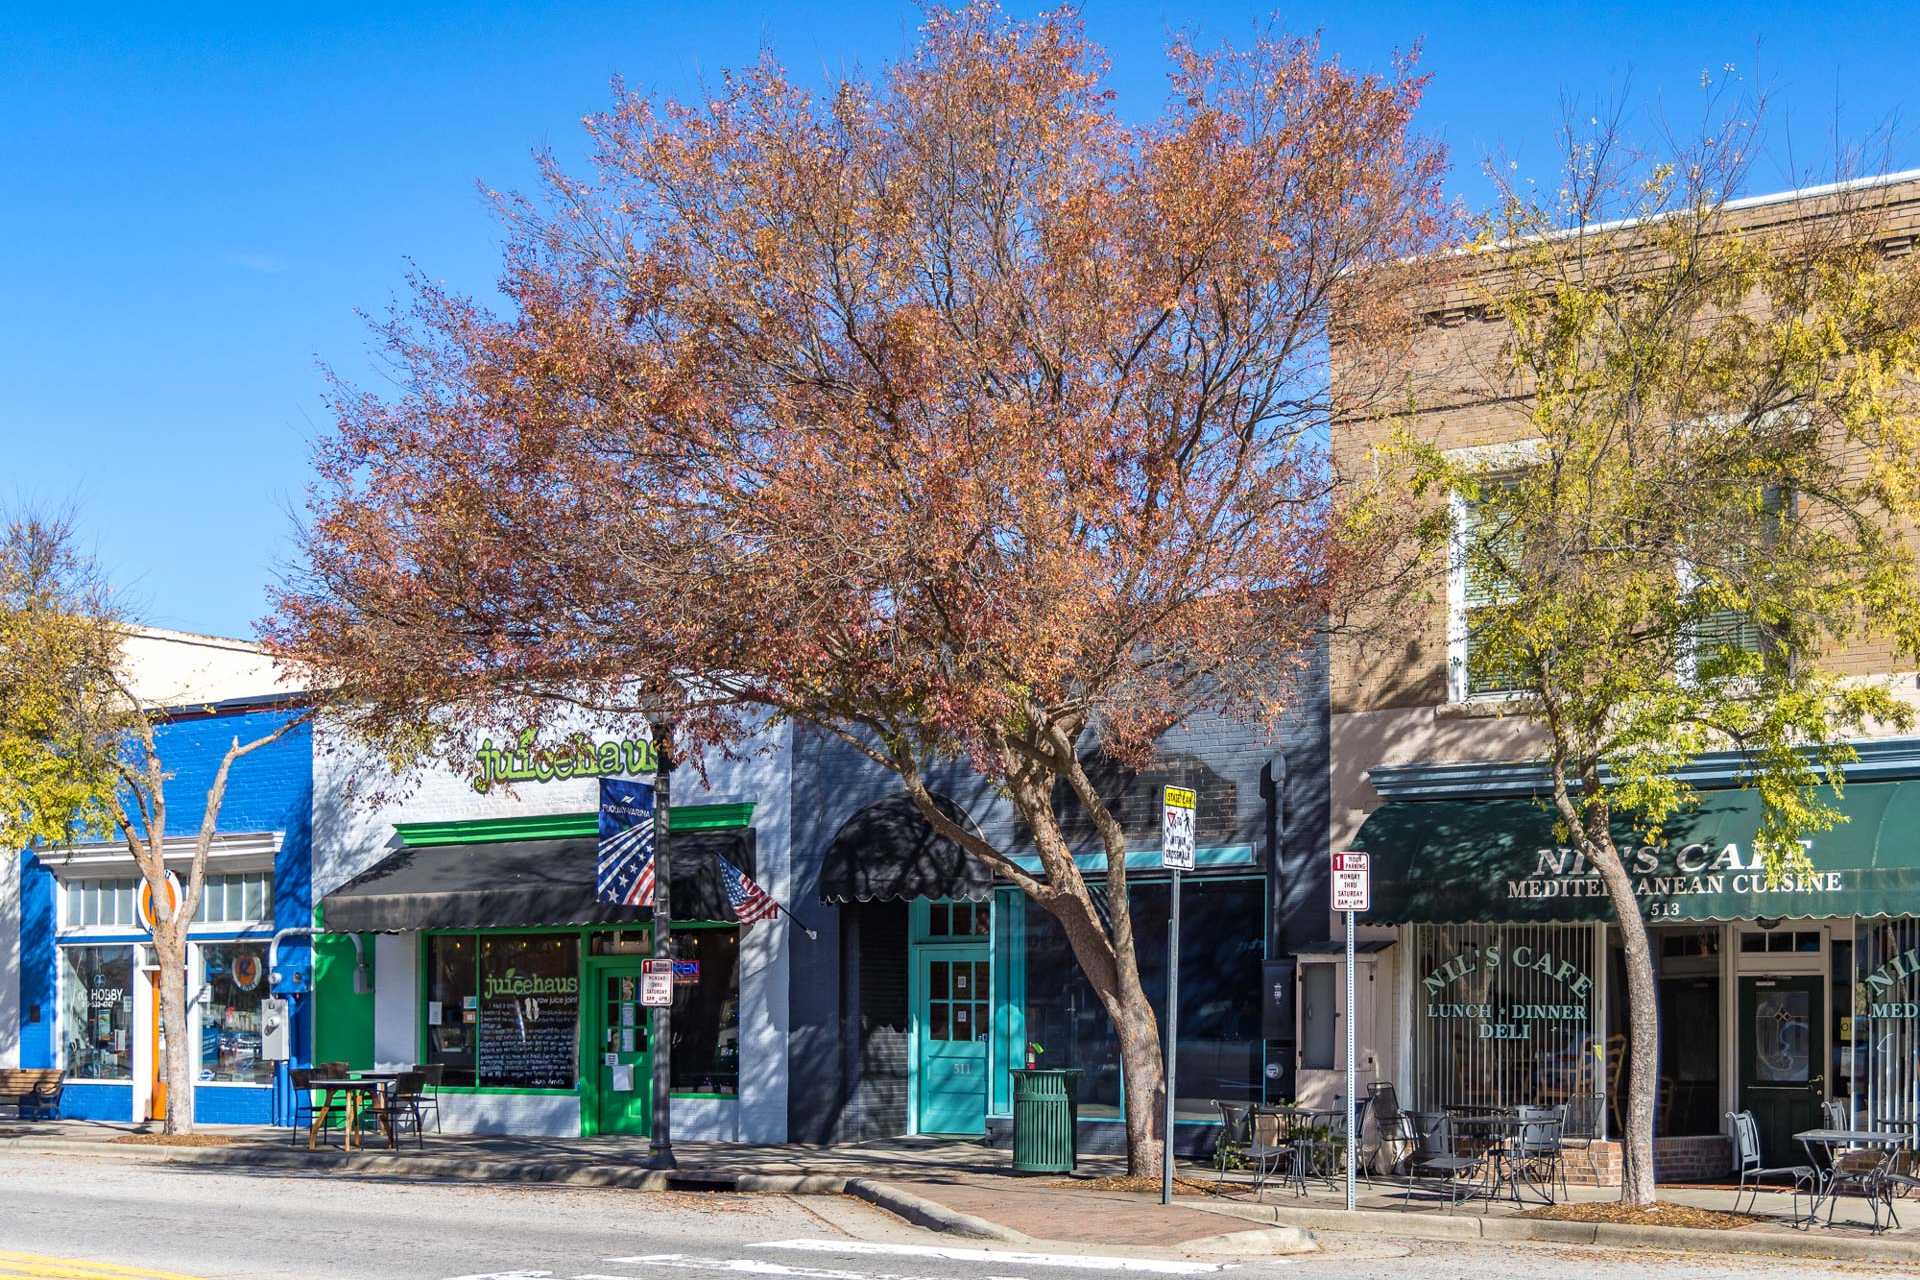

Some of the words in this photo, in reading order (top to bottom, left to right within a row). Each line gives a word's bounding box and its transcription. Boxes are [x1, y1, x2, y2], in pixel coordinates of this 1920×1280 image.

[1335, 855, 1341, 870] 1
[1532, 846, 1660, 876] NI'S
[1344, 881, 1358, 889] THRU
[1508, 876, 1725, 898] MEDITEANEAN
[1650, 902, 1680, 916] 513
[1422, 945, 1501, 996] NIL'S
[1512, 946, 1594, 999] CAFE
[484, 969, 578, 999] juicehaus
[91, 988, 123, 1001] HOBBY
[1428, 1003, 1492, 1018] LUNCH
[1511, 1004, 1587, 1020] DINNER
[1479, 1023, 1531, 1040] DELI
[953, 1063, 971, 1074] 511
